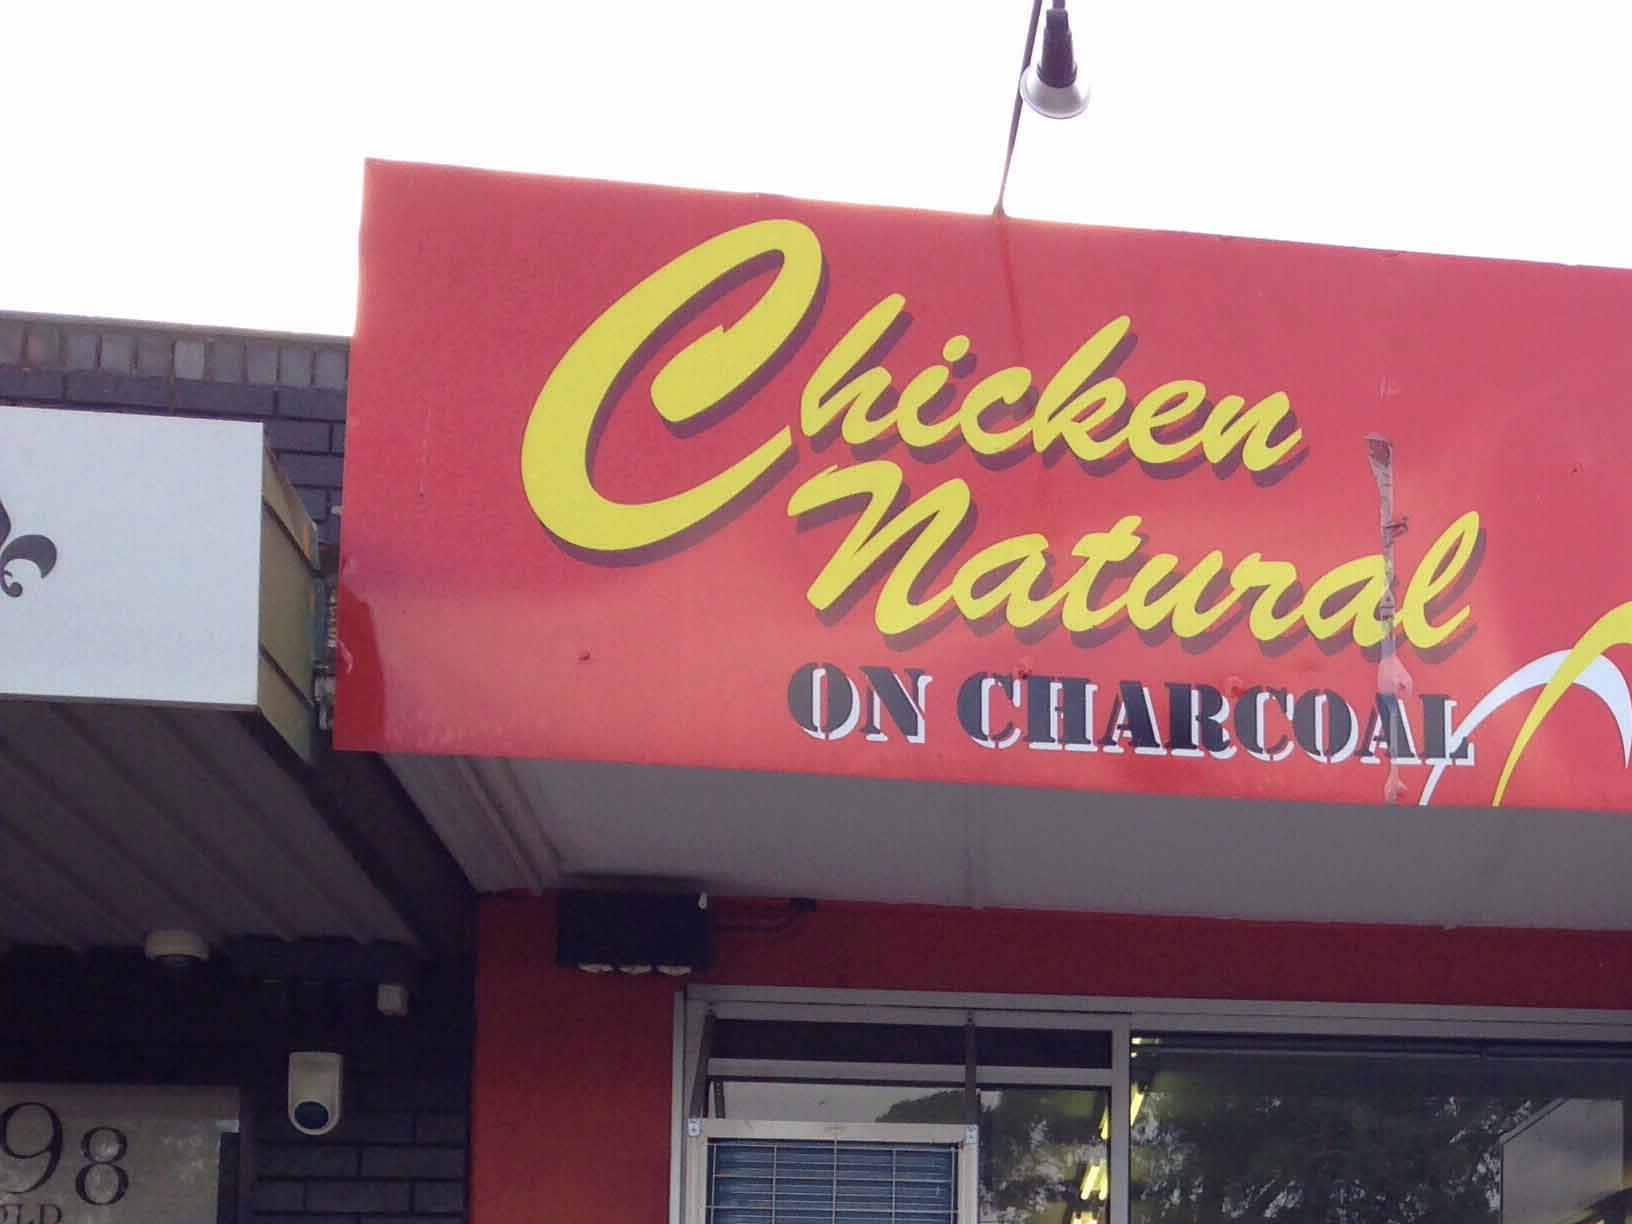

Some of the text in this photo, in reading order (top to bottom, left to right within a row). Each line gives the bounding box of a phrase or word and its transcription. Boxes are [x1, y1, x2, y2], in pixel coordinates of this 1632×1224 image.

[521, 219, 1304, 553] Chicken
[787, 460, 1481, 650] Natural
[788, 662, 1476, 767] ON CHARCOAL
